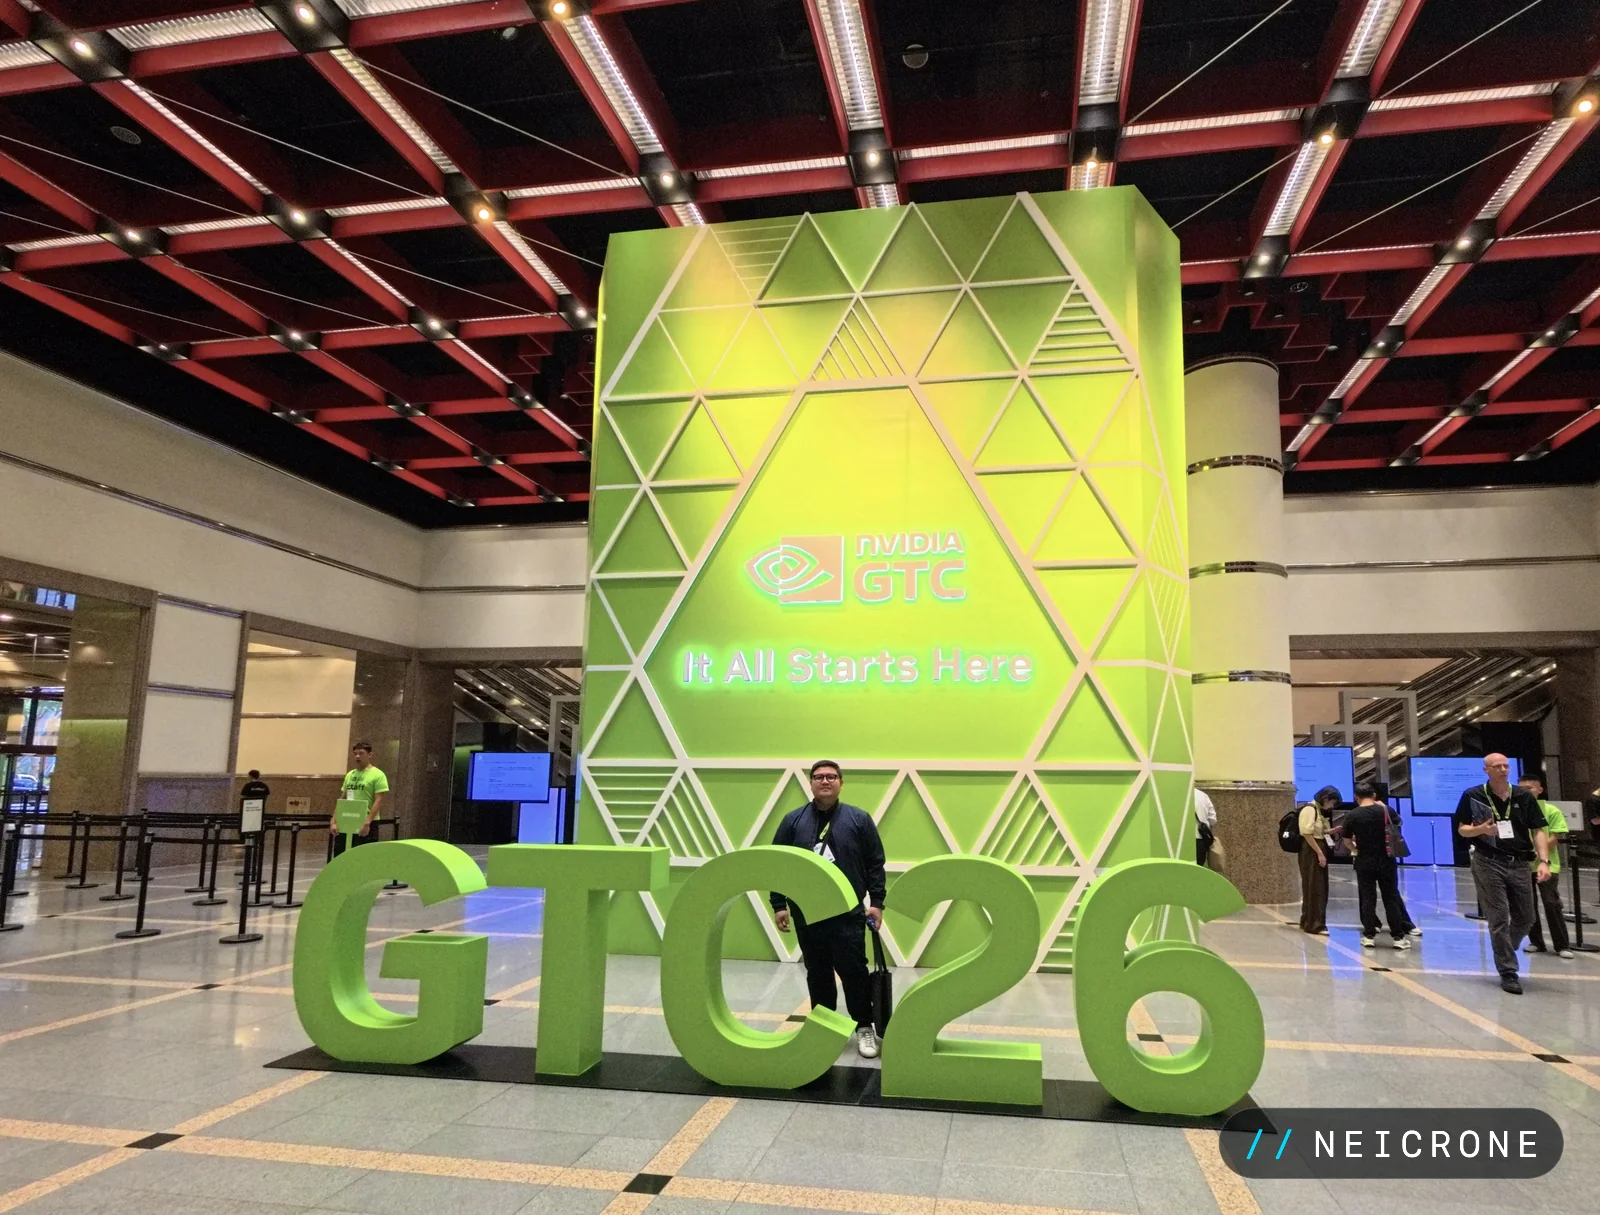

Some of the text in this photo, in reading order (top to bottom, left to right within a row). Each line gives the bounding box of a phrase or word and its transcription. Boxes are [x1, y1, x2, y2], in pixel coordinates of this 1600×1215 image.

[853, 559, 966, 602] GTC
[682, 647, 1033, 683] It All Starts Here
[293, 839, 1266, 1117] GTC26
